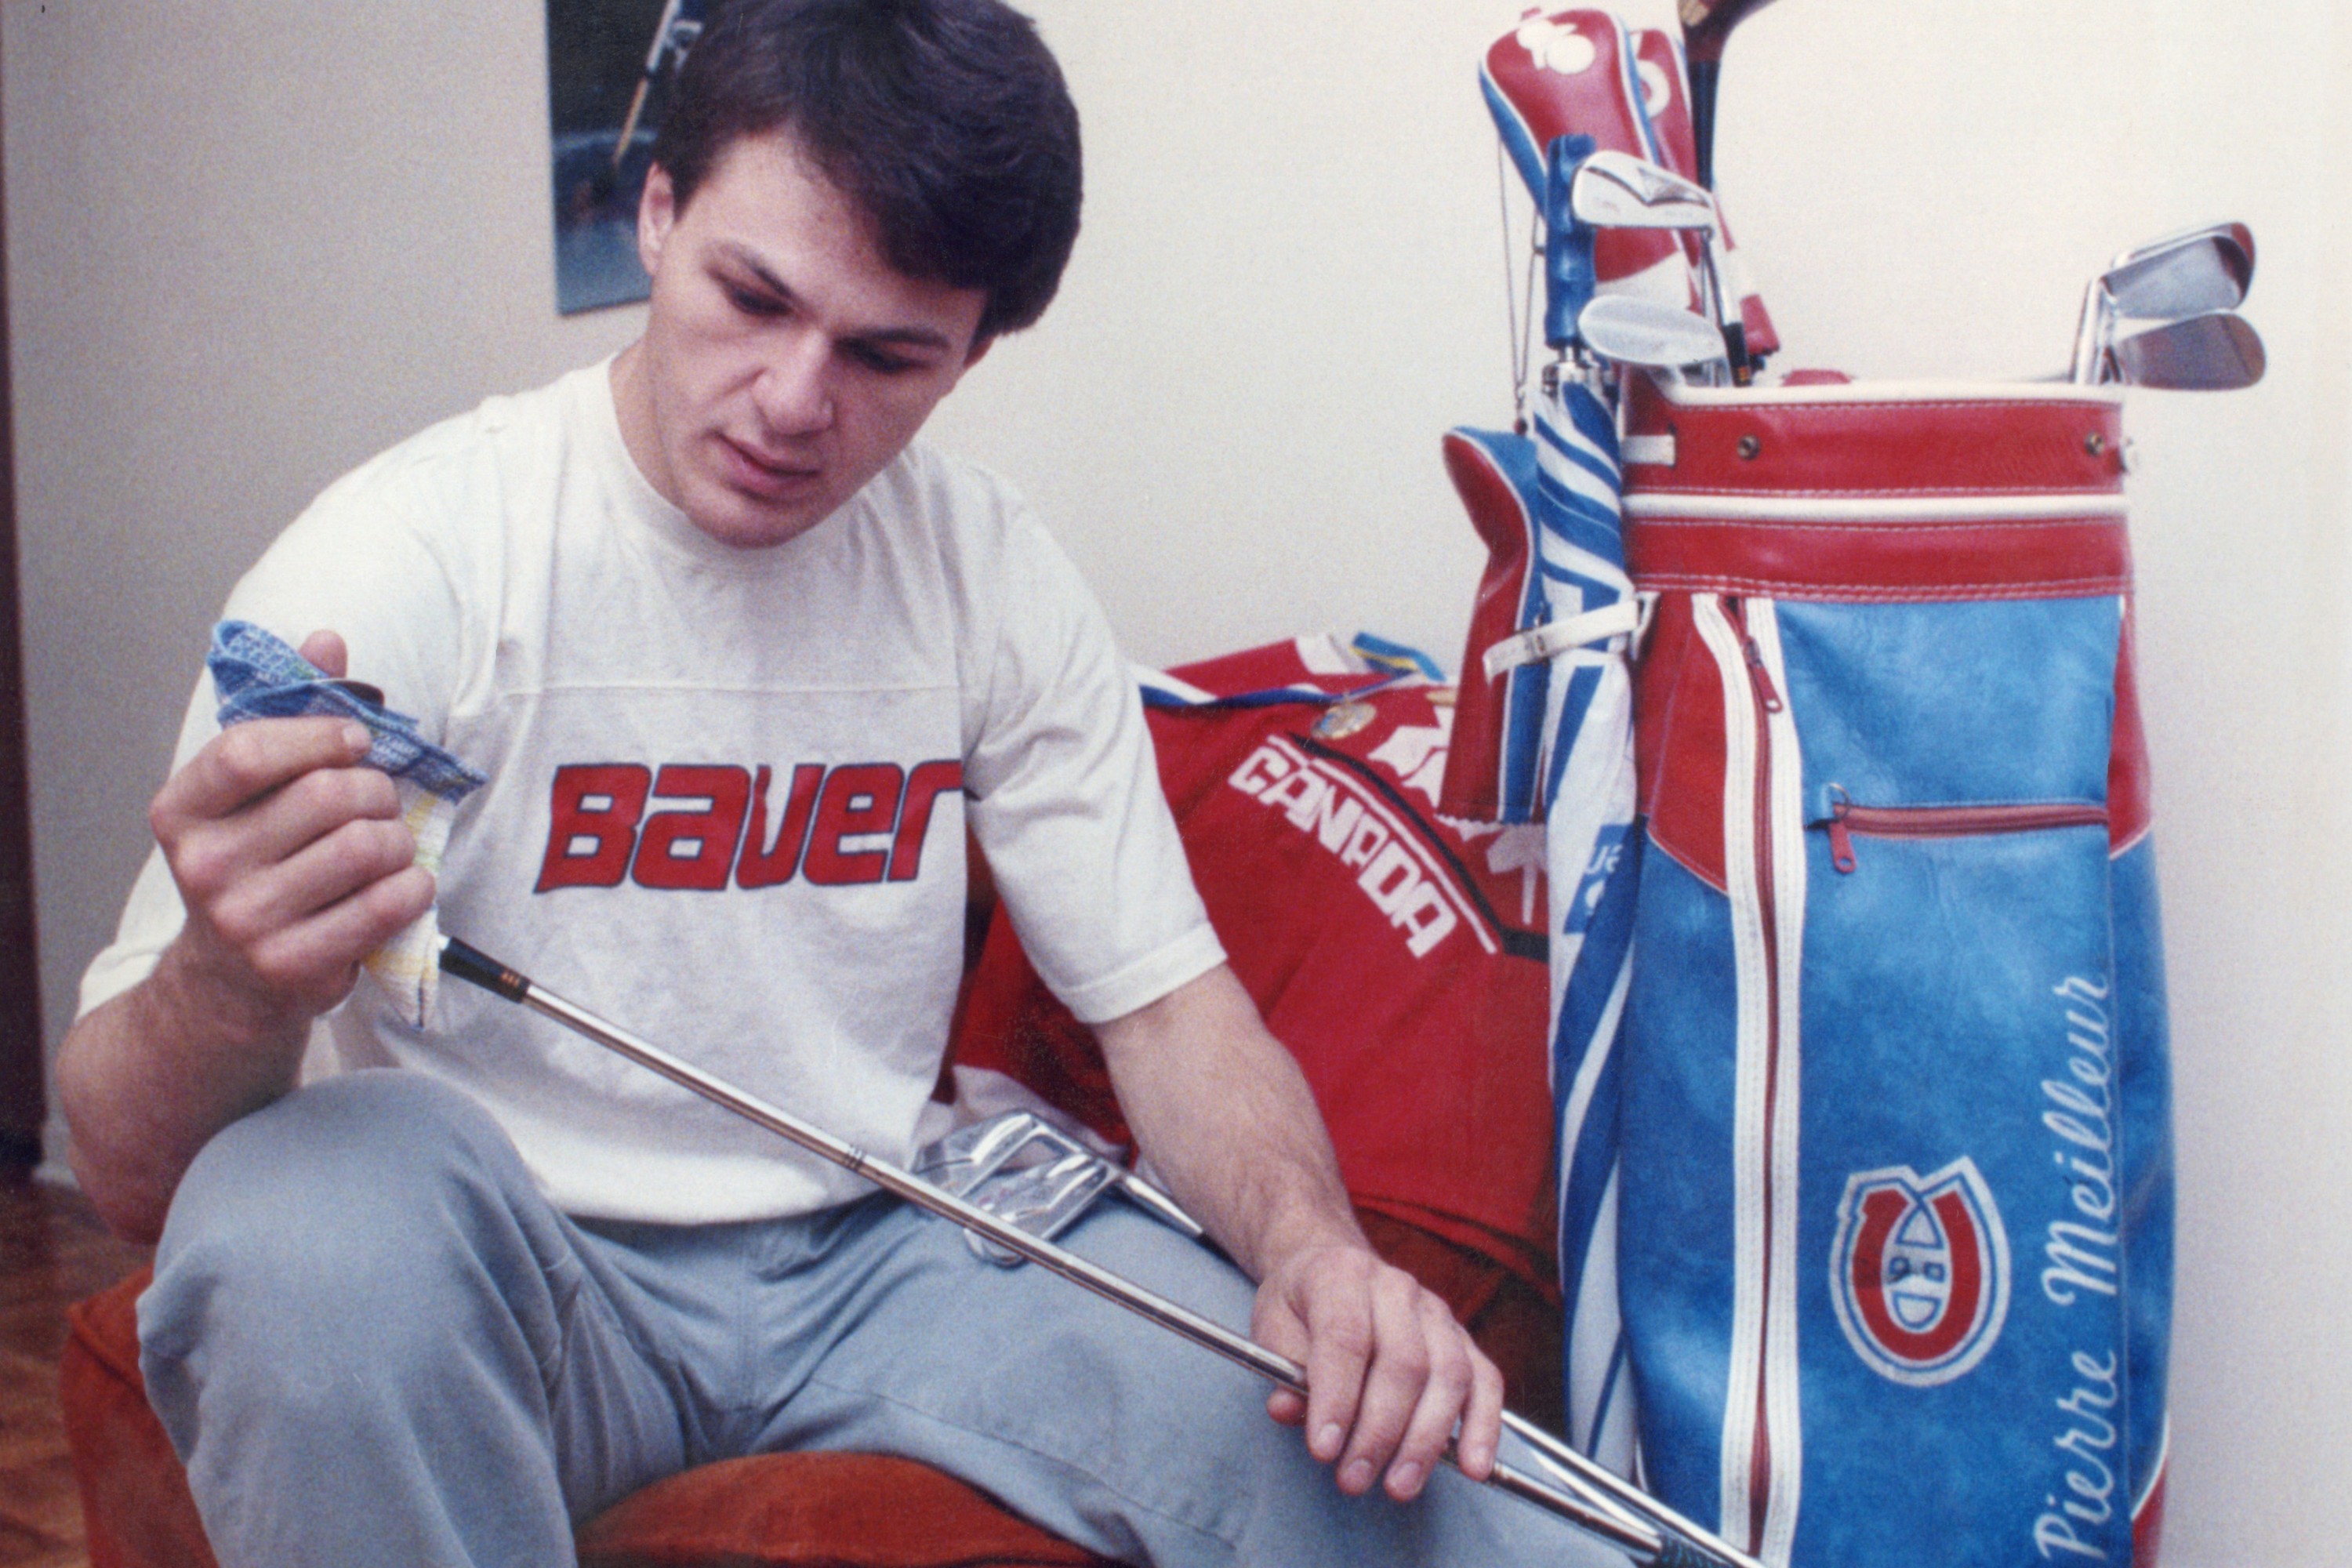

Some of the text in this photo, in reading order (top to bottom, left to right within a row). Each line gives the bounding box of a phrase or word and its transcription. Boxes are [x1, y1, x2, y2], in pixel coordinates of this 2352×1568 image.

[533, 760, 962, 894] Bauer
[1228, 746, 1457, 958] CANADA
[2033, 973, 2118, 1560] Pierre Meilleur
